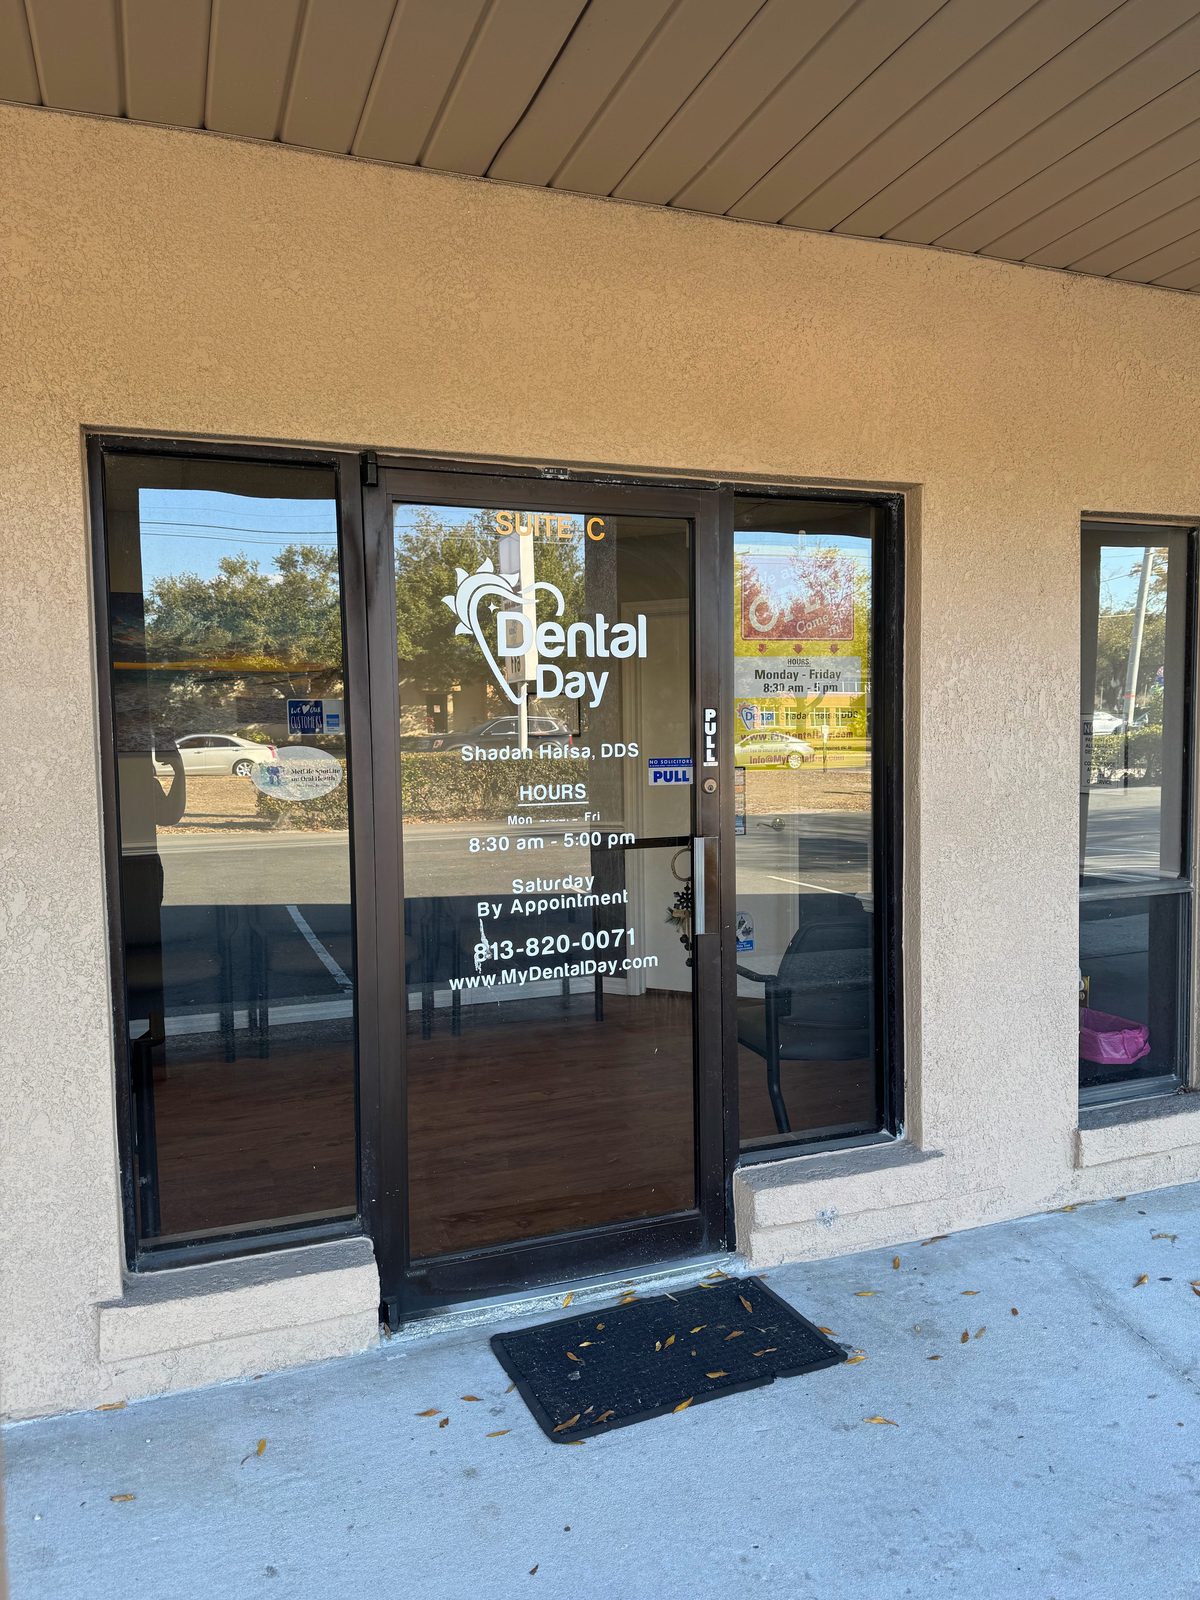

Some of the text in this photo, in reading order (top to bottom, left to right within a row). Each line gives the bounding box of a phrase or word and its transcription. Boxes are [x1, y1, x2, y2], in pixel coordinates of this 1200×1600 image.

[495, 511, 606, 541] SUITE C
[796, 614, 830, 634] Come
[497, 611, 648, 659] Dental
[787, 658, 810, 666] HOURS
[754, 669, 799, 681] Monday
[809, 669, 841, 681] Friday
[536, 664, 609, 709] Day
[763, 683, 785, 693] 8:30
[788, 684, 804, 693] am
[823, 685, 838, 695] pm
[703, 708, 717, 762] PULL
[461, 745, 532, 761] Shadan
[601, 742, 639, 758] DDS
[653, 769, 690, 783] PULL
[519, 783, 586, 801] HOURS
[507, 815, 533, 825] Mon
[584, 812, 601, 822] Fri
[469, 837, 510, 853] 8:30
[516, 837, 544, 851] am
[563, 832, 602, 848] 5:00
[608, 832, 636, 849] pm
[512, 875, 595, 894] Saturday
[477, 889, 628, 919] By Appointment
[473, 928, 635, 963] 813-820-0071
[449, 955, 659, 991] www.MyDentalDay.com
